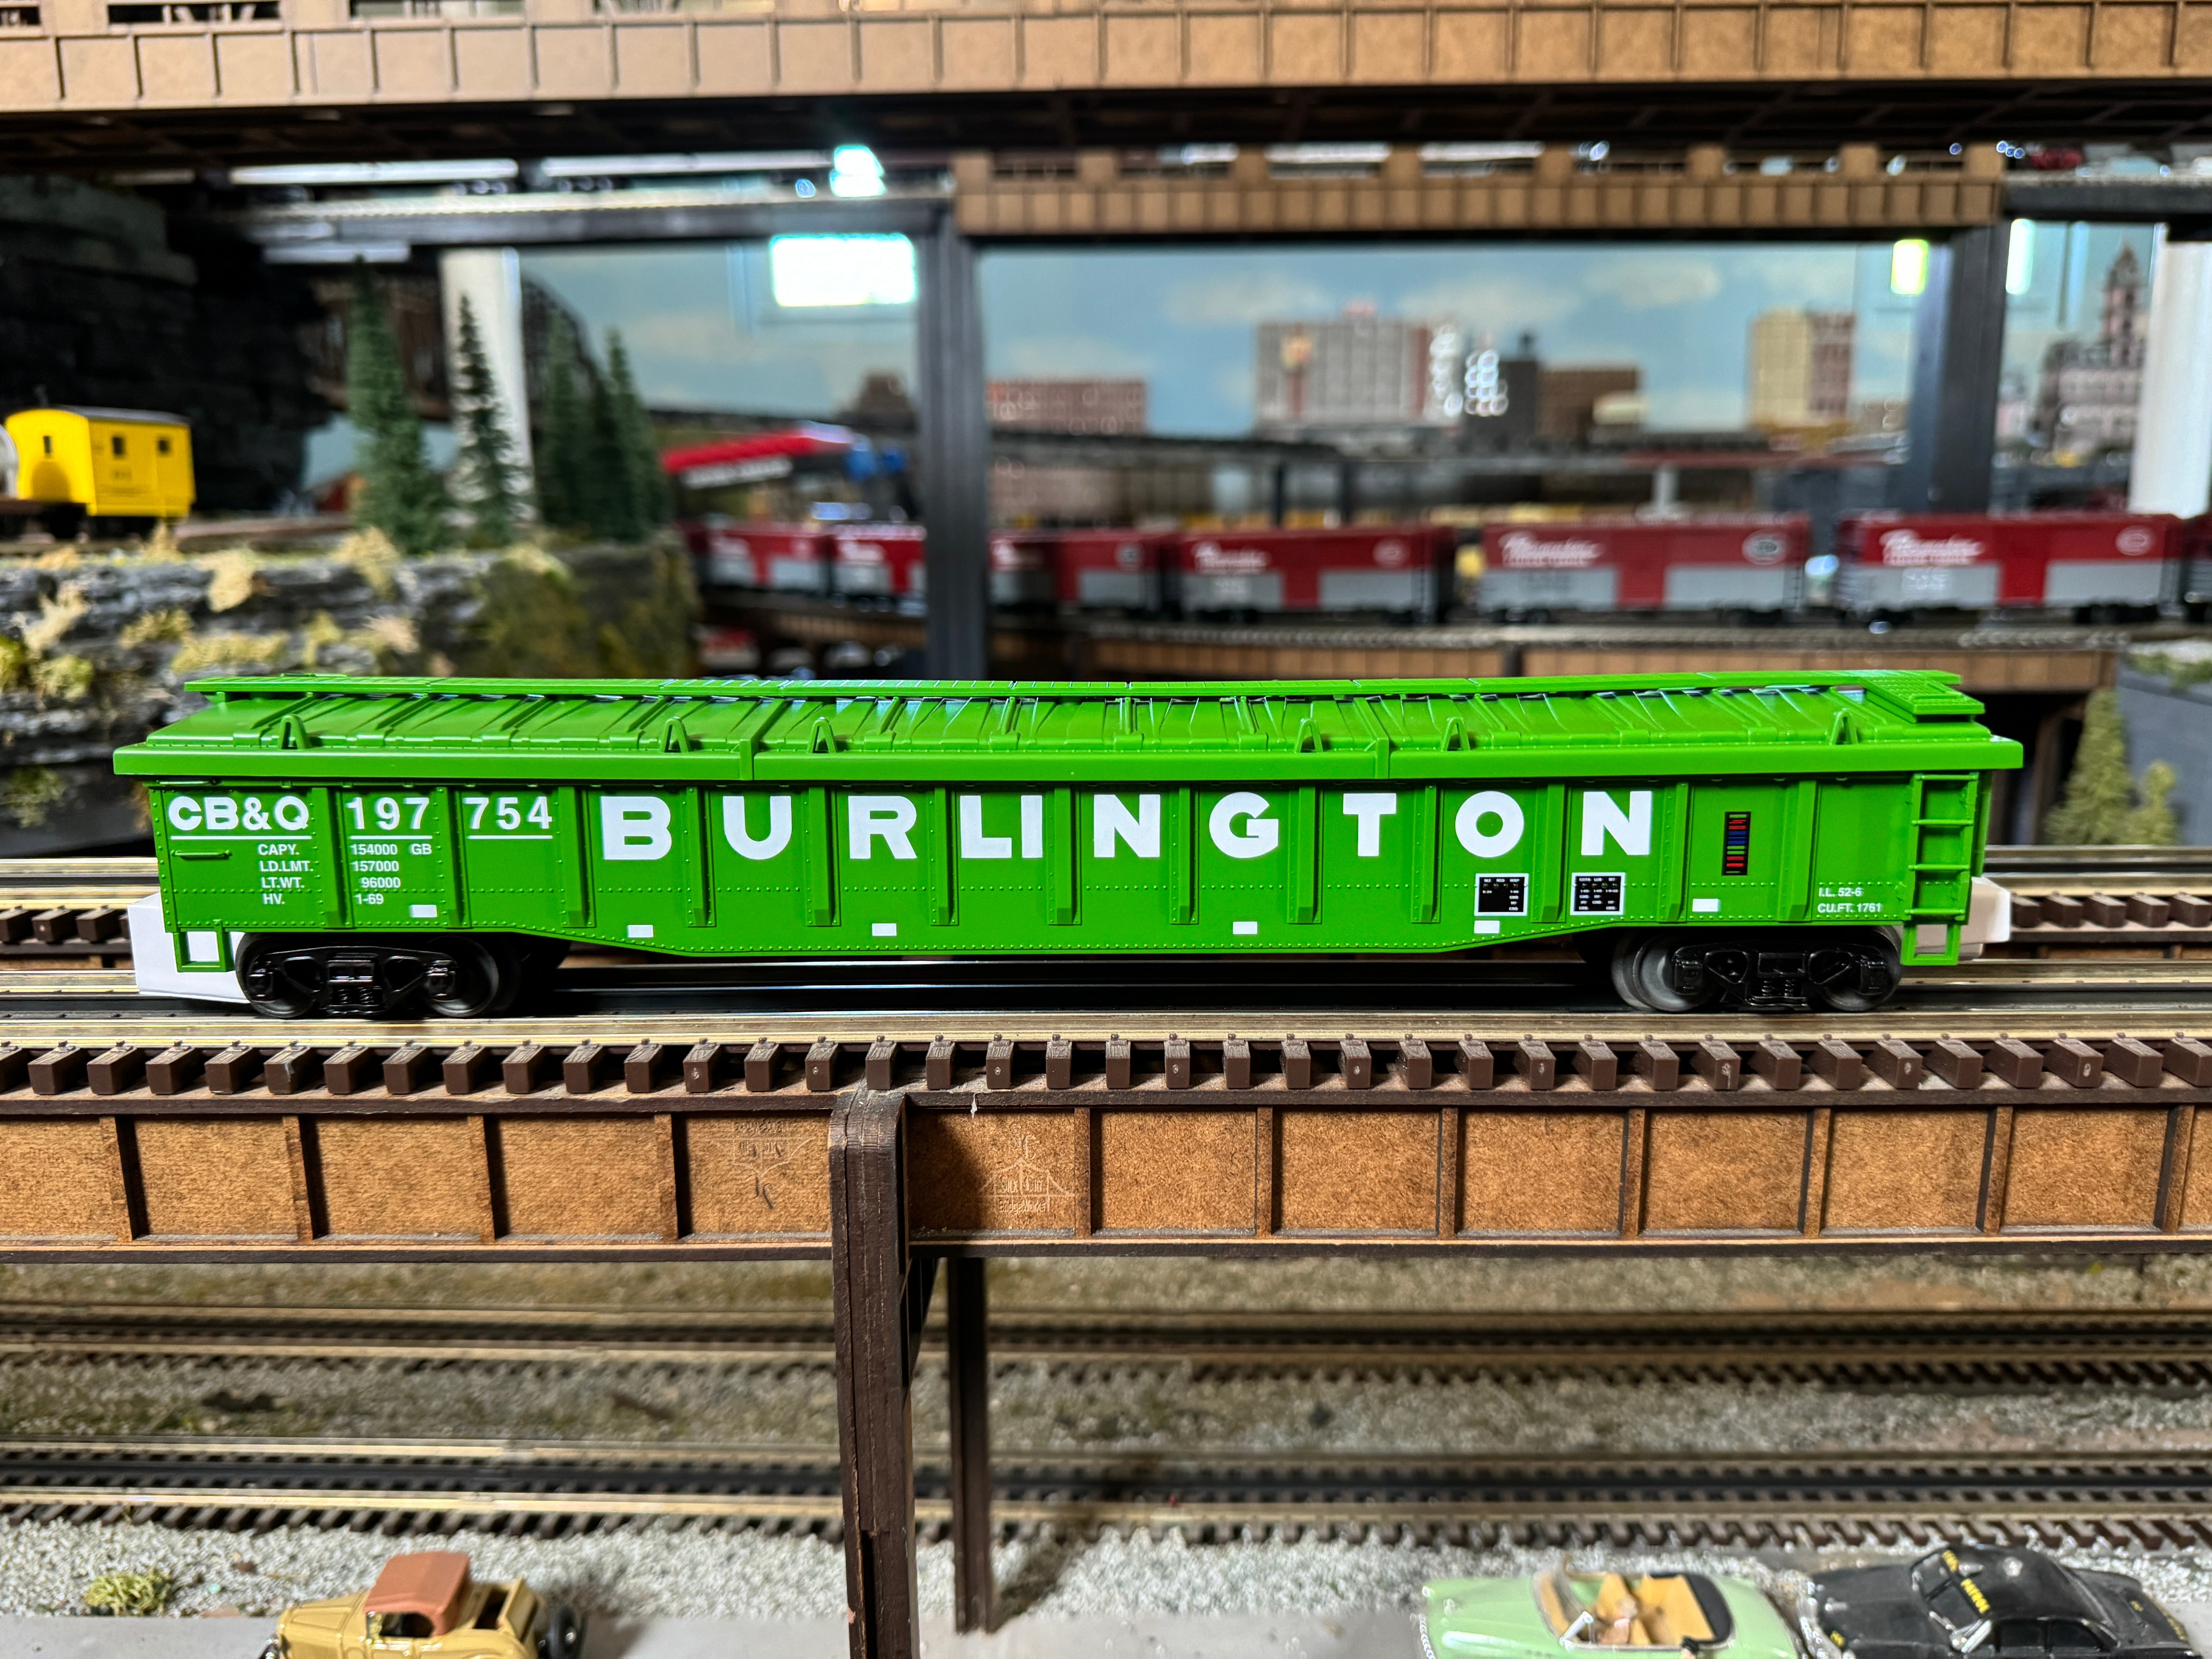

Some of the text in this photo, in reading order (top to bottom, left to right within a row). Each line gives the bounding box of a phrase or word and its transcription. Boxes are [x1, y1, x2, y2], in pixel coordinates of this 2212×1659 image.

[168, 796, 552, 831] CB&Q 197 754
[601, 791, 1652, 861] BURLINGTON
[258, 843, 431, 855] CAPY. 154000 GB
[259, 860, 399, 872] LD.LMT. 157000
[261, 877, 400, 888] LT.WT. 96000
[1819, 887, 1862, 897] I.L. 52-6
[263, 893, 383, 904] HV. 1-69
[1817, 903, 1881, 913] CU.FT. 1761
